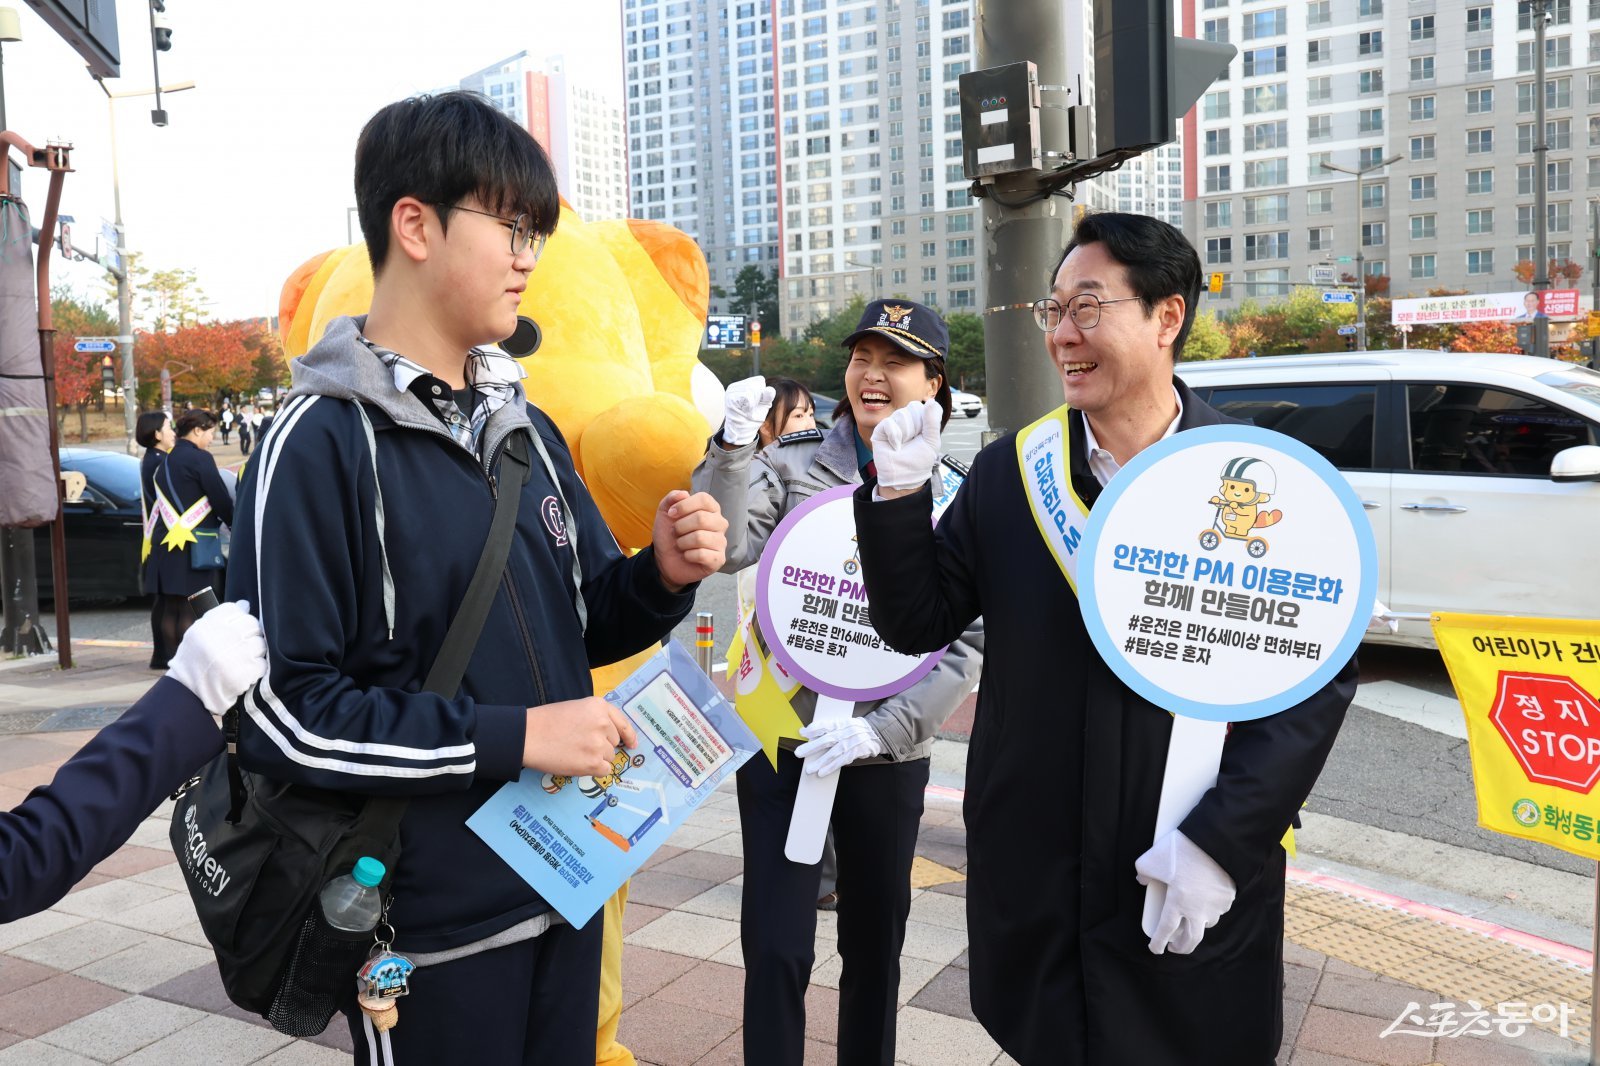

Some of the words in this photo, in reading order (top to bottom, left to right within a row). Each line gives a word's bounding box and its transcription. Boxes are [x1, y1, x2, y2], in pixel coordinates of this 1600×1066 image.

[1397, 312, 1413, 322] 모든
[1416, 311, 1440, 320] 청년의
[1442, 310, 1467, 320] 도전을
[1470, 306, 1516, 318] 응원합니다!
[1034, 451, 1061, 515] 안전한
[1054, 509, 1082, 556] PM
[782, 566, 836, 594] 안전한
[838, 580, 866, 602] PM
[1113, 543, 1189, 580] 안전한
[1193, 557, 1234, 587] PM
[1241, 564, 1344, 605] 이용문화
[802, 594, 838, 618] 함께
[1143, 580, 1194, 612] 함께
[1200, 589, 1300, 628] 만들어요
[786, 634, 825, 654] #탑승은
[826, 642, 848, 658] 혼자
[790, 618, 828, 638] #운전은
[830, 626, 882, 649] 만16세이상
[1128, 614, 1182, 638] #운전은
[1186, 622, 1260, 651] 만16세이상
[1264, 636, 1322, 661] 면허부터
[1124, 636, 1178, 660] #탑승은
[1182, 644, 1212, 666] 혼자
[1472, 636, 1562, 662] 어린이가
[1521, 728, 1600, 765] STOP
[513, 804, 532, 823] 시행
[508, 820, 546, 854] 이동장치(PM)
[528, 819, 554, 844] 반납제
[542, 852, 560, 869] 개인형
[549, 840, 567, 858] 대여
[558, 867, 579, 887] 동탄지역
[563, 855, 594, 883] 지정위치
